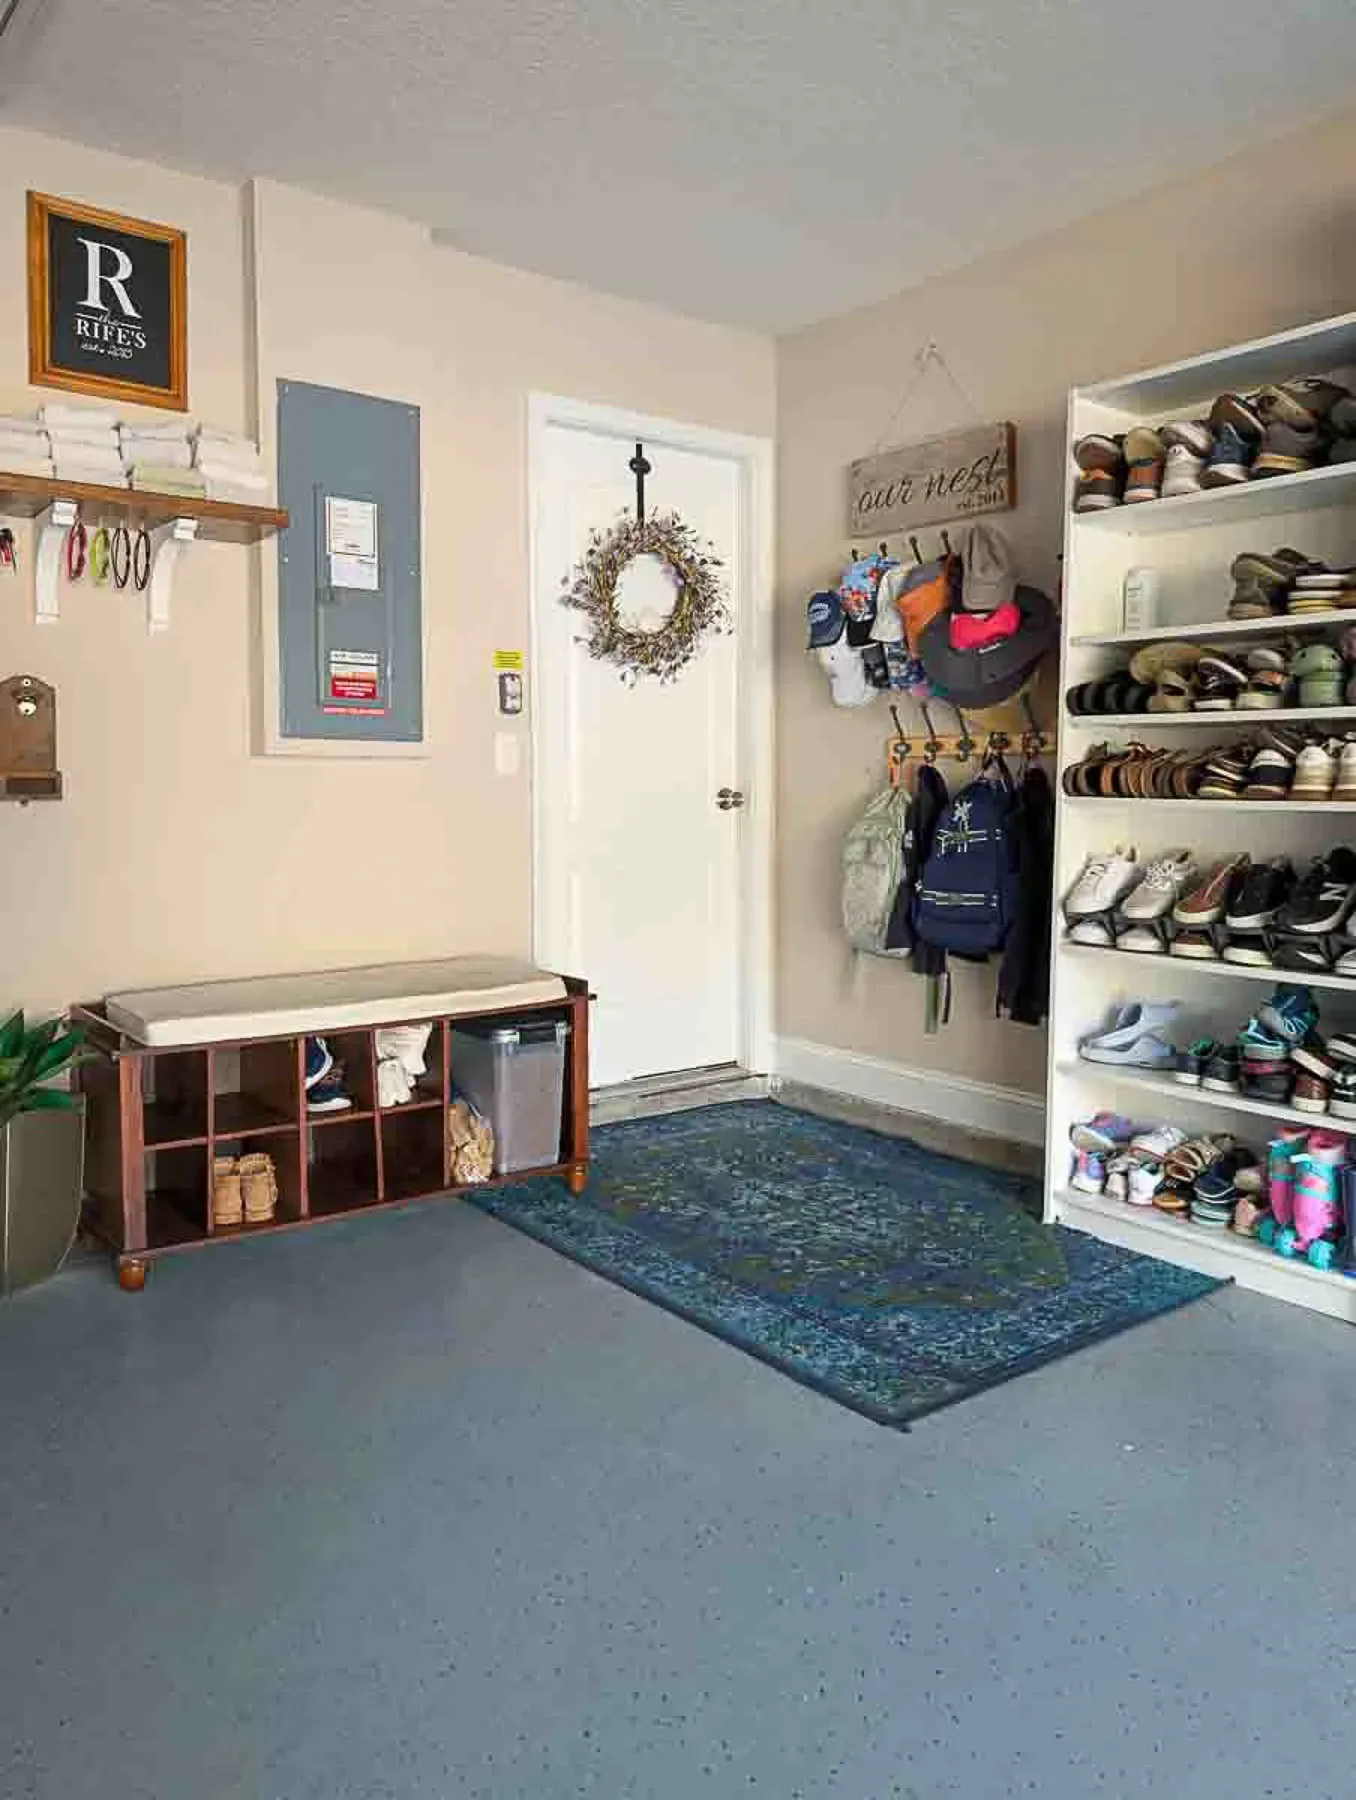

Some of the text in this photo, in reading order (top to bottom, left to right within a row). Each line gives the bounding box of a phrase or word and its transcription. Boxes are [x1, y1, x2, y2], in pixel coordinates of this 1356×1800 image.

[77, 237, 142, 318] R
[76, 318, 147, 349] RIFE'S
[858, 447, 1008, 514] our nest
